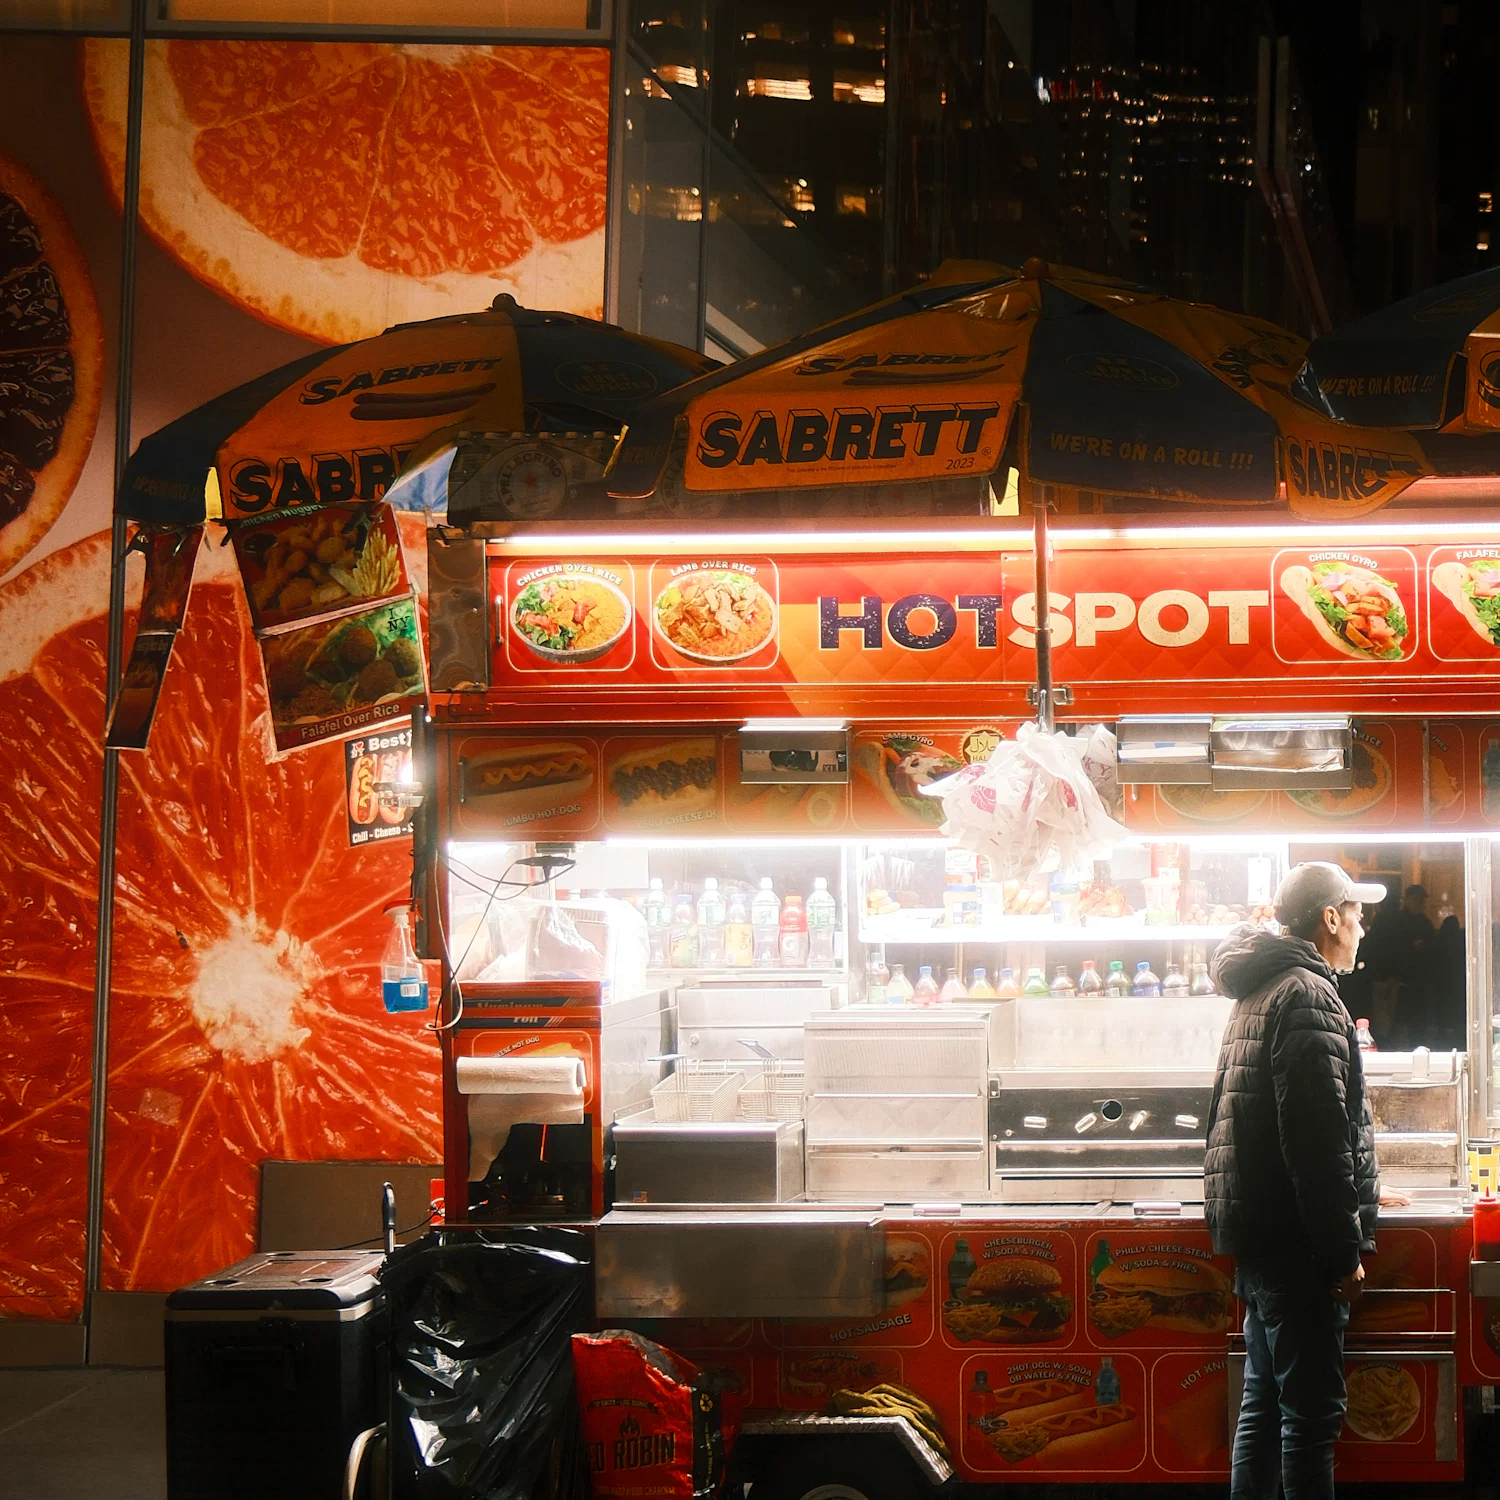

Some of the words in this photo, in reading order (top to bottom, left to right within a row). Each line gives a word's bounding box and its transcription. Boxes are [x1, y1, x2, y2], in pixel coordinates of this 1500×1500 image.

[299, 358, 502, 405] SABRETT
[697, 402, 1000, 468] SABRETT
[1050, 432, 1112, 457] WE'RE
[1118, 443, 1149, 461] ON
[1154, 446, 1166, 463] A
[1174, 447, 1223, 469] ROLL
[945, 456, 975, 470] 2023
[1309, 551, 1350, 563] CHICKEN
[1351, 553, 1378, 569] GYRO
[1456, 550, 1500, 560] FALAFEL
[517, 564, 562, 586] CHICKEN
[566, 563, 594, 574] OVER
[597, 569, 623, 586] RICE
[670, 562, 698, 577] LAMB
[702, 560, 728, 569] OVER
[732, 562, 757, 575] RICE
[387, 616, 411, 632] NY
[301, 719, 341, 739] Falafel
[343, 712, 370, 728] Over
[373, 703, 400, 719] Rice
[909, 735, 934, 746] GYRO
[503, 812, 535, 828] JUMBO
[537, 808, 558, 820] HOT
[559, 803, 581, 815] DOG
[374, 825, 402, 838] Cheese
[512, 1040, 525, 1049] HOT
[526, 1036, 541, 1045] DOG
[983, 1237, 1053, 1250] CHEESEBURGER
[997, 1247, 1020, 1258] SODA
[1021, 1248, 1029, 1256] &
[1030, 1249, 1056, 1261] FRIES
[1115, 1245, 1146, 1258] PHILLY
[1149, 1244, 1183, 1254] CHEESE
[1185, 1246, 1214, 1260] STEAK
[1133, 1260, 1160, 1270] SODA
[1171, 1260, 1198, 1274] FRIES
[829, 1328, 854, 1343] HOT
[856, 1313, 912, 1337] SAUSAGE
[1006, 1362, 1030, 1376] 2HOT
[1031, 1361, 1051, 1370] DOG
[1053, 1361, 1066, 1370] W/
[1068, 1362, 1093, 1377] SODA
[1180, 1368, 1203, 1390] HOT
[1204, 1359, 1229, 1376] KNI
[1009, 1373, 1022, 1384] OR
[1023, 1371, 1056, 1383] WATER
[1057, 1372, 1065, 1380] &
[1066, 1373, 1092, 1387] FRIES
[614, 1431, 677, 1472] ROBIN
